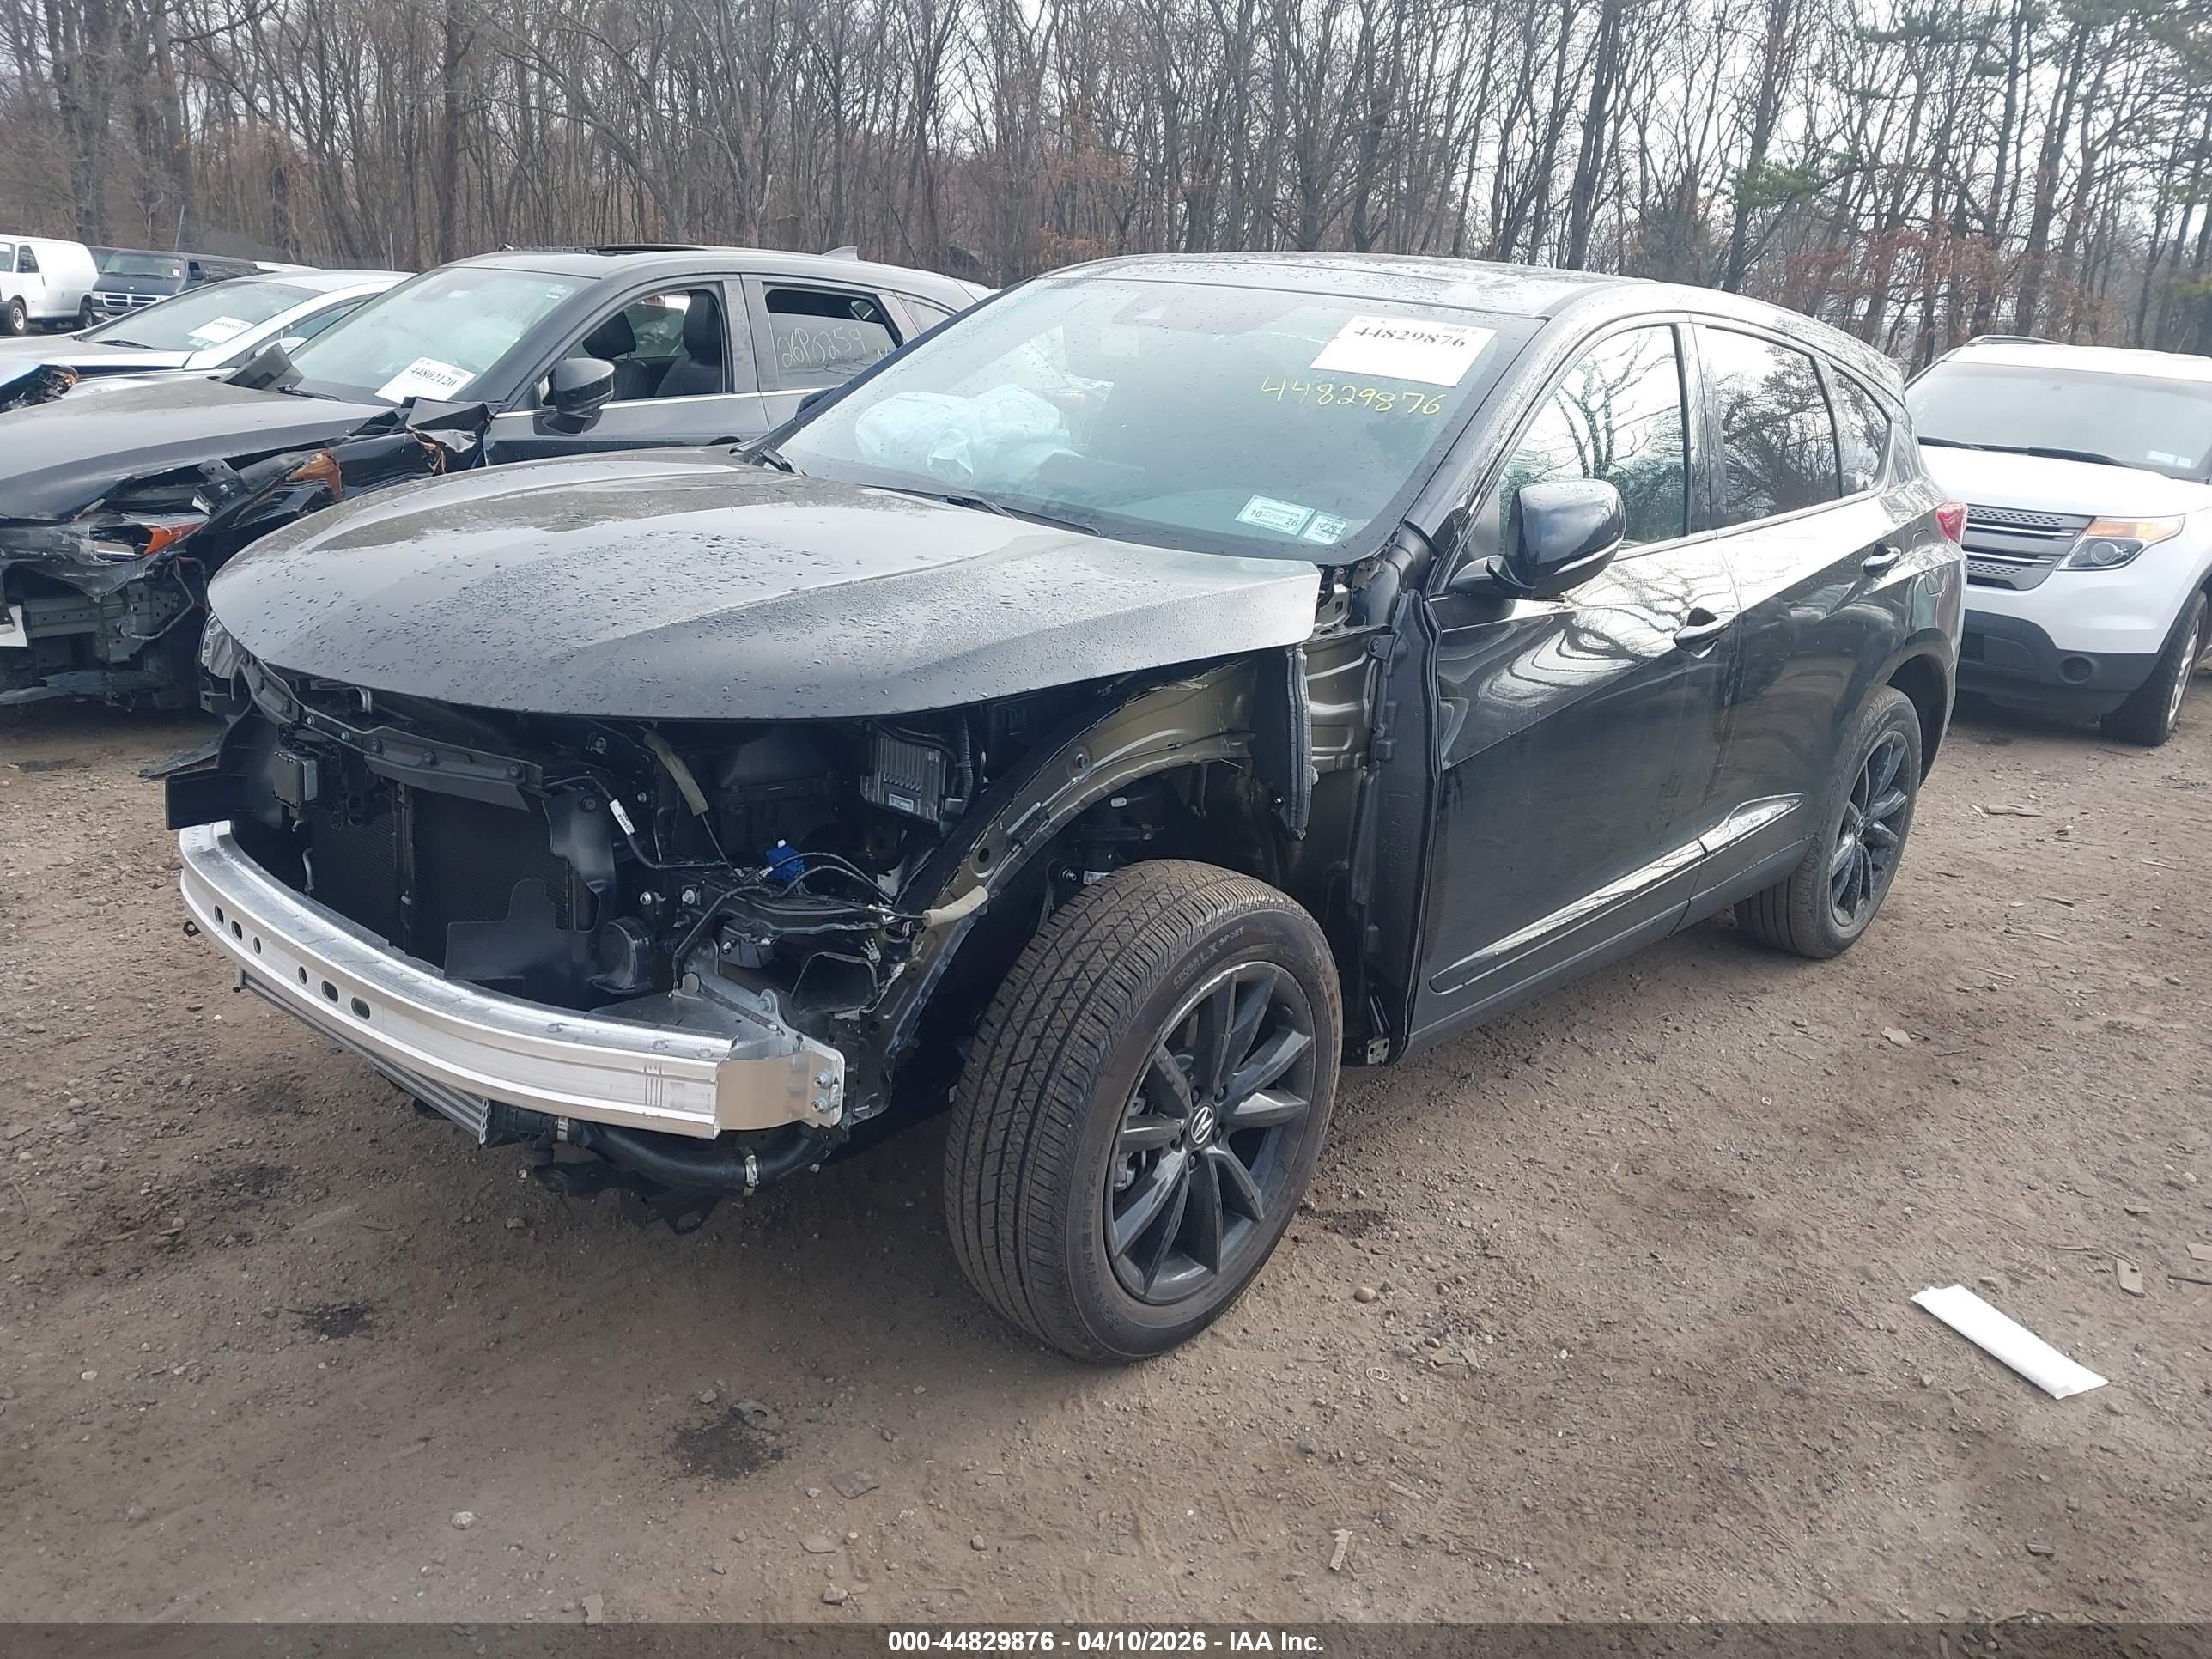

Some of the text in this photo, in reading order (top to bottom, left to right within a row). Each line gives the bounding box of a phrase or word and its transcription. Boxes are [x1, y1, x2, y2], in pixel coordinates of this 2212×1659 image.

[1354, 326, 1466, 347] 44829876
[411, 366, 458, 387] 44802120
[1261, 376, 1447, 415] 44829876
[1285, 517, 1298, 526] 26
[1218, 927, 1243, 945] SPORT
